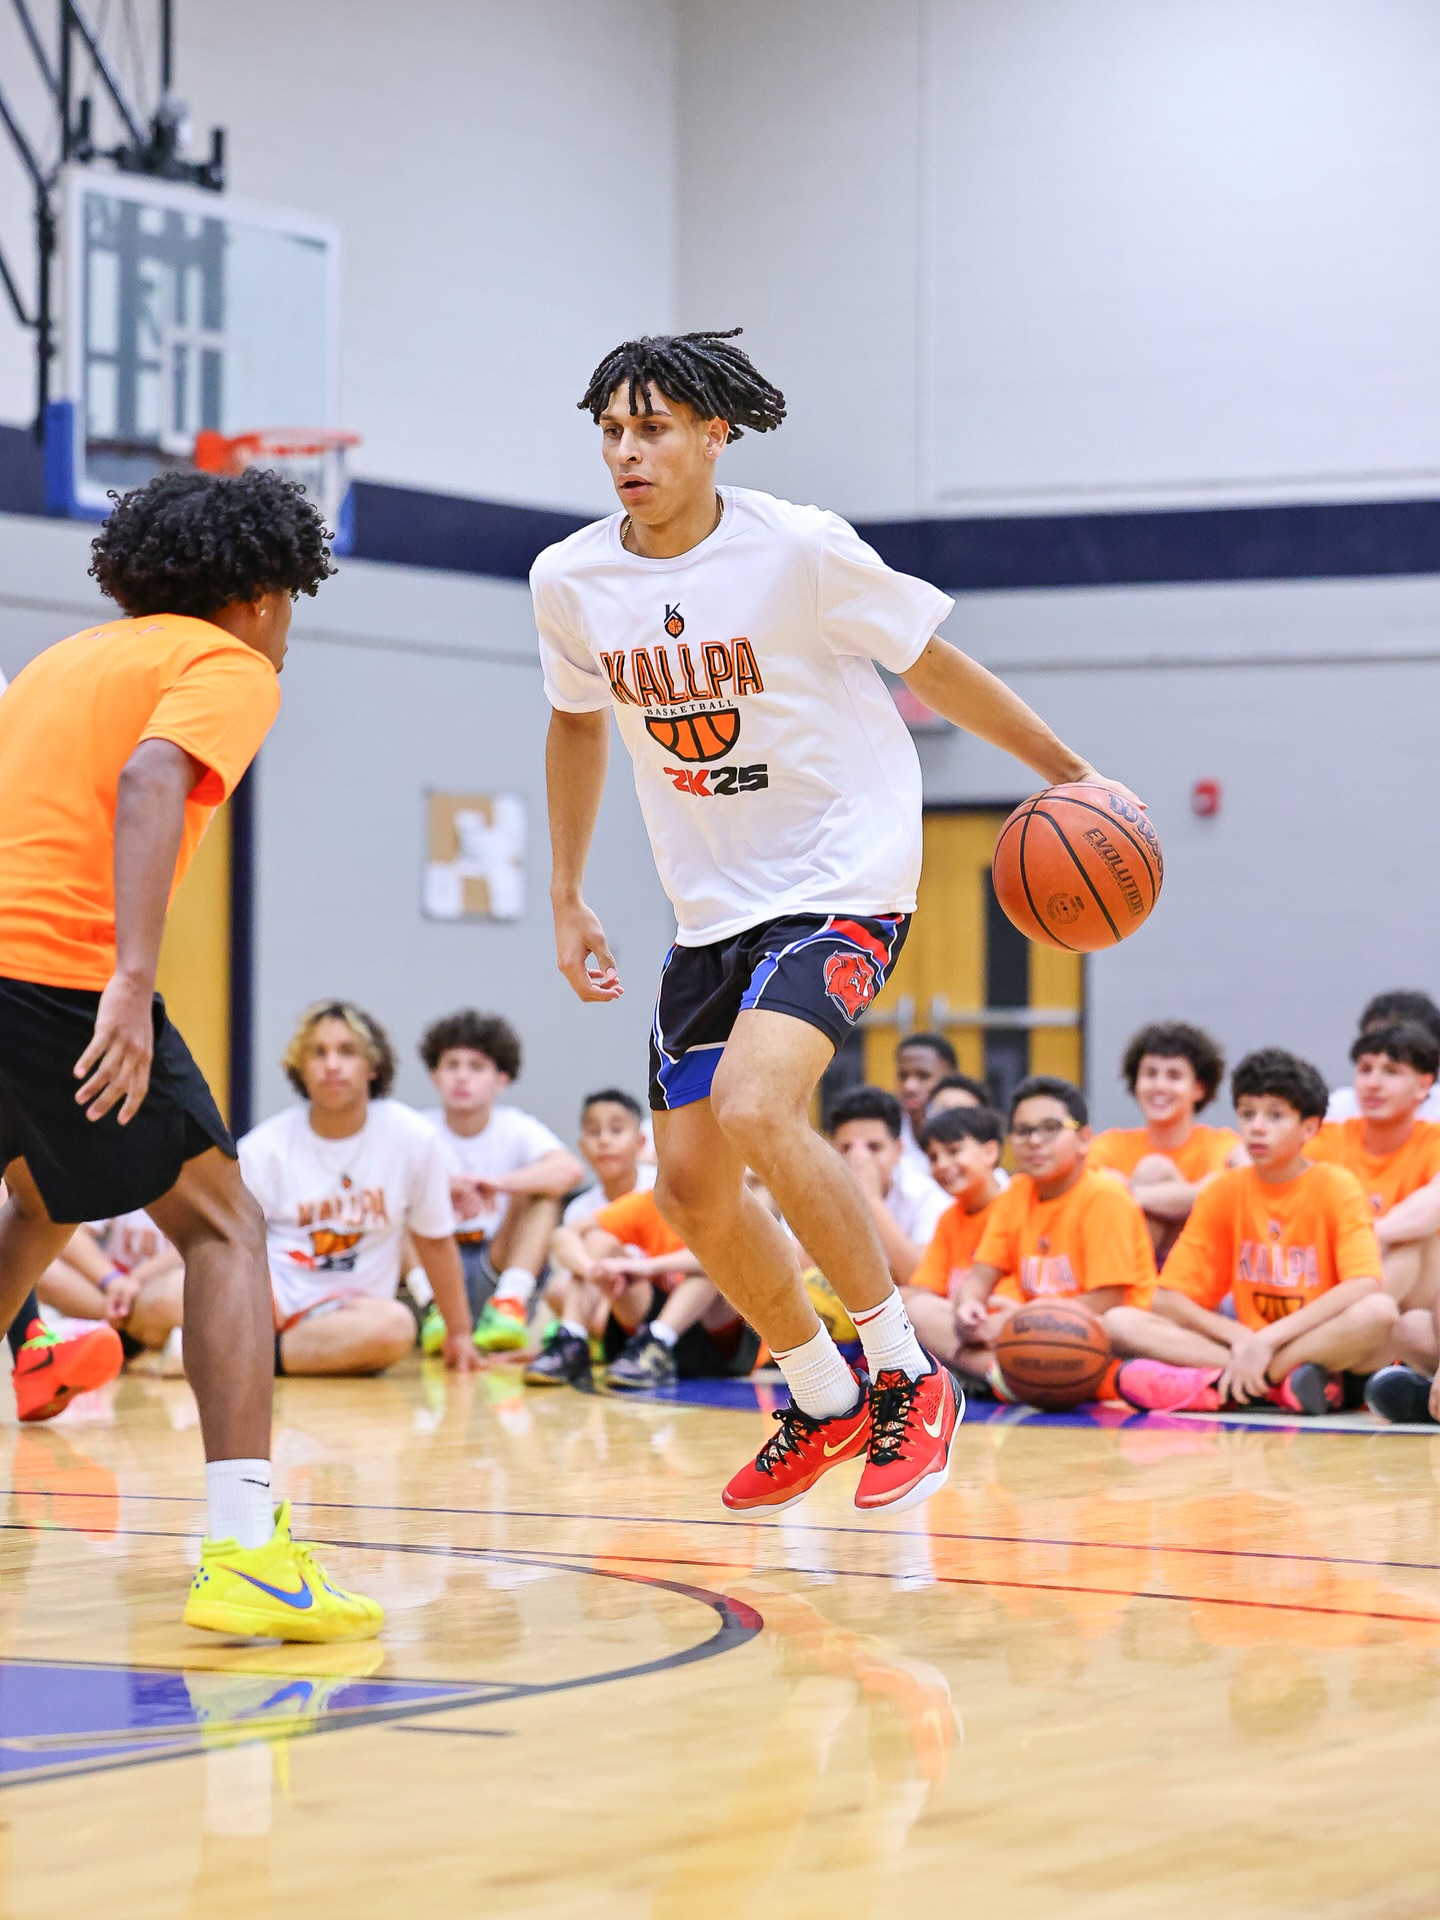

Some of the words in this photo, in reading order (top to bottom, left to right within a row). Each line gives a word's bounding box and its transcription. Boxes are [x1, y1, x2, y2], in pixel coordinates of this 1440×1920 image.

[599, 636, 765, 707] KALLPA
[646, 699, 735, 717] BASKETBALL
[663, 763, 769, 797] 2K25
[1086, 827, 1145, 915] EVOLUTION
[1237, 1240, 1321, 1289] KALLPA
